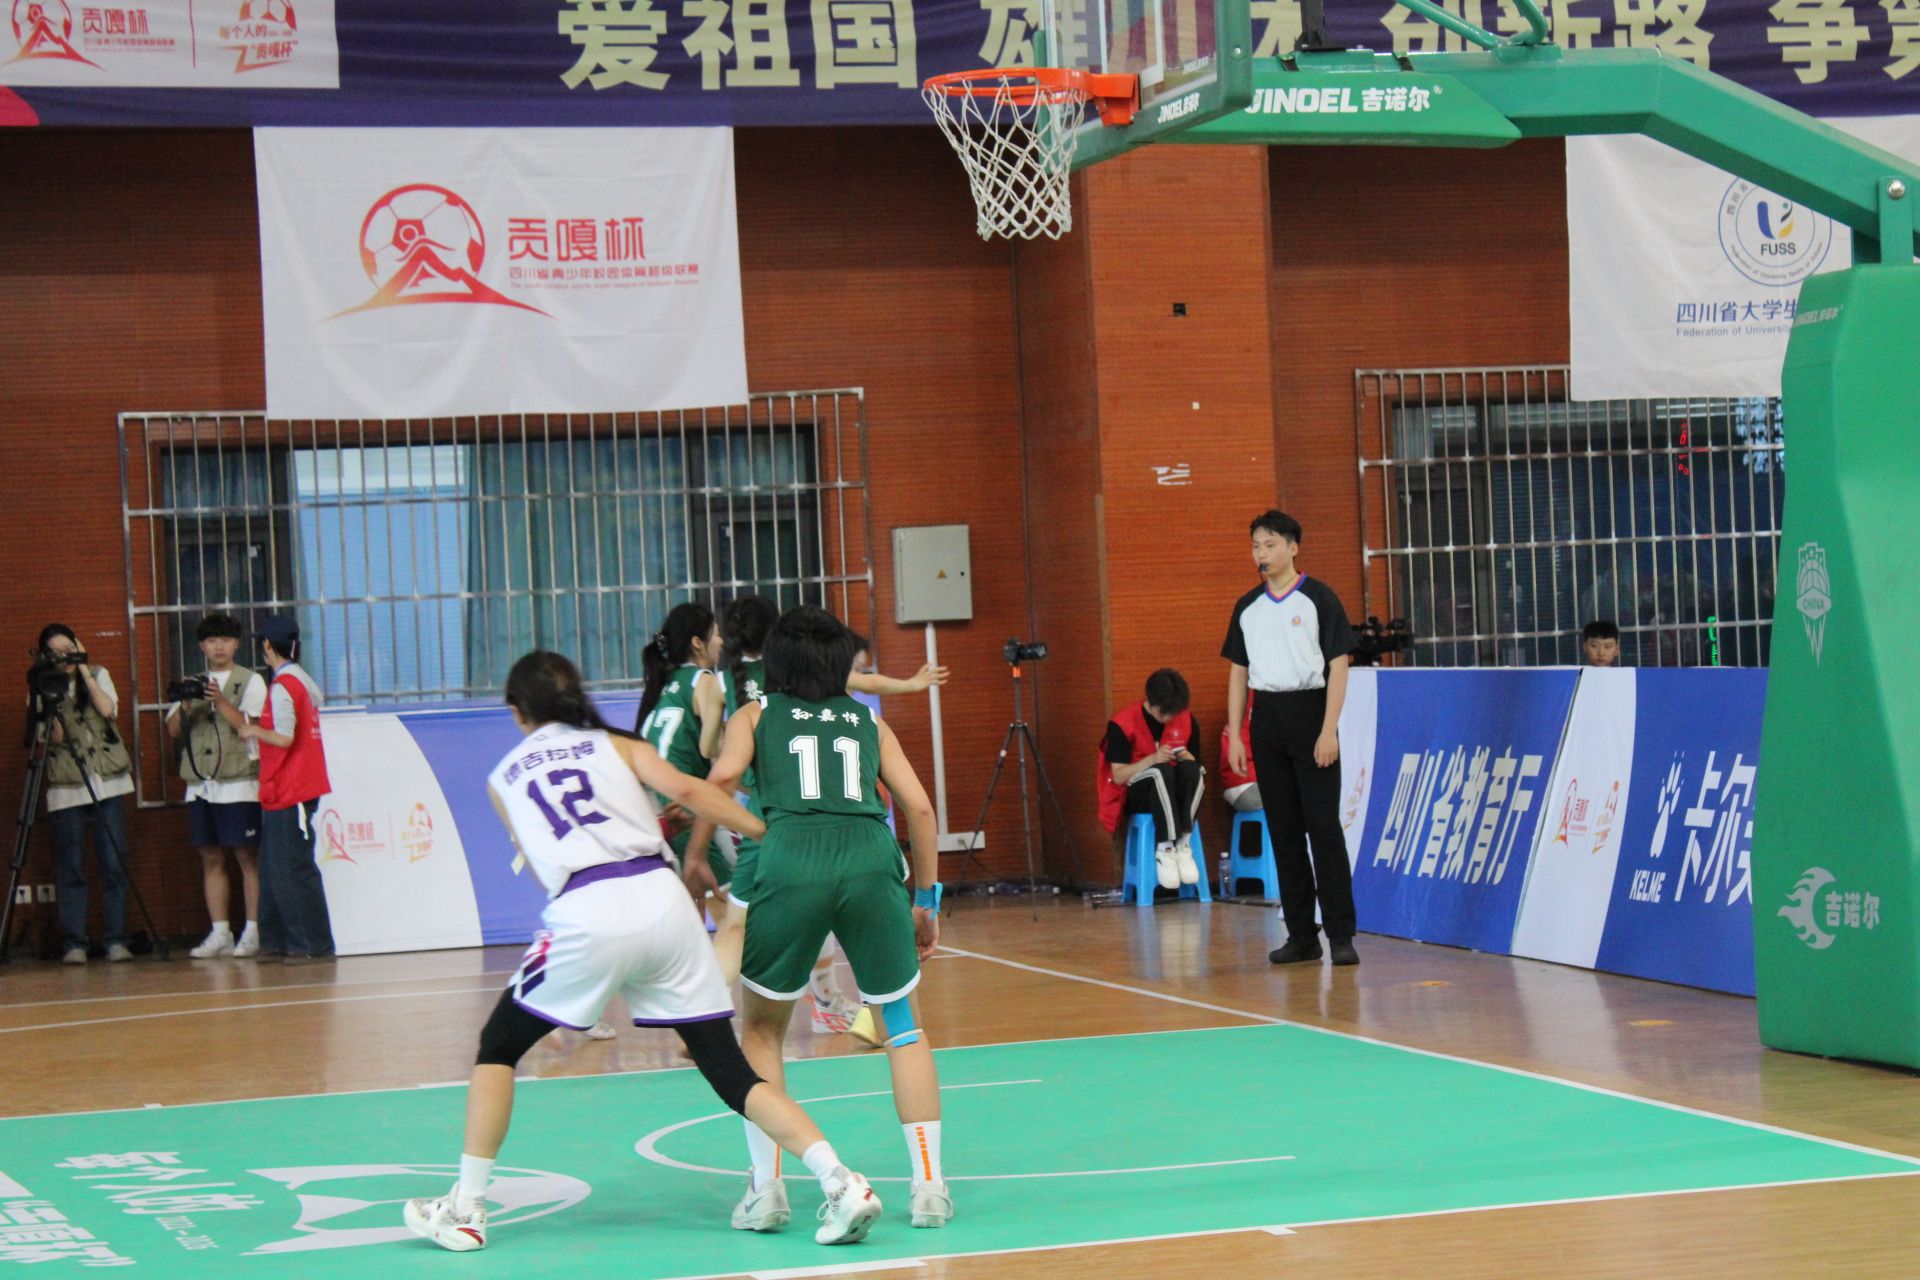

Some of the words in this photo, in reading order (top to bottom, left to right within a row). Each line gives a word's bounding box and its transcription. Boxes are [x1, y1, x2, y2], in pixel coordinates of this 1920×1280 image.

[557, 0, 917, 90] 爱祖国
[1244, 88, 1358, 114] JINOEL
[1361, 86, 1430, 112] 吉诺尔
[508, 217, 646, 262] 贡嘎杯
[1760, 242, 1797, 256] FUSS
[1676, 325, 1729, 337] Federation
[1732, 325, 1742, 336] of
[788, 735, 862, 803] 11
[526, 767, 612, 842] 12
[1373, 744, 1544, 886] 四川省教育厅
[1629, 869, 1666, 904] KELME
[1824, 891, 1881, 930] 吉诺尔
